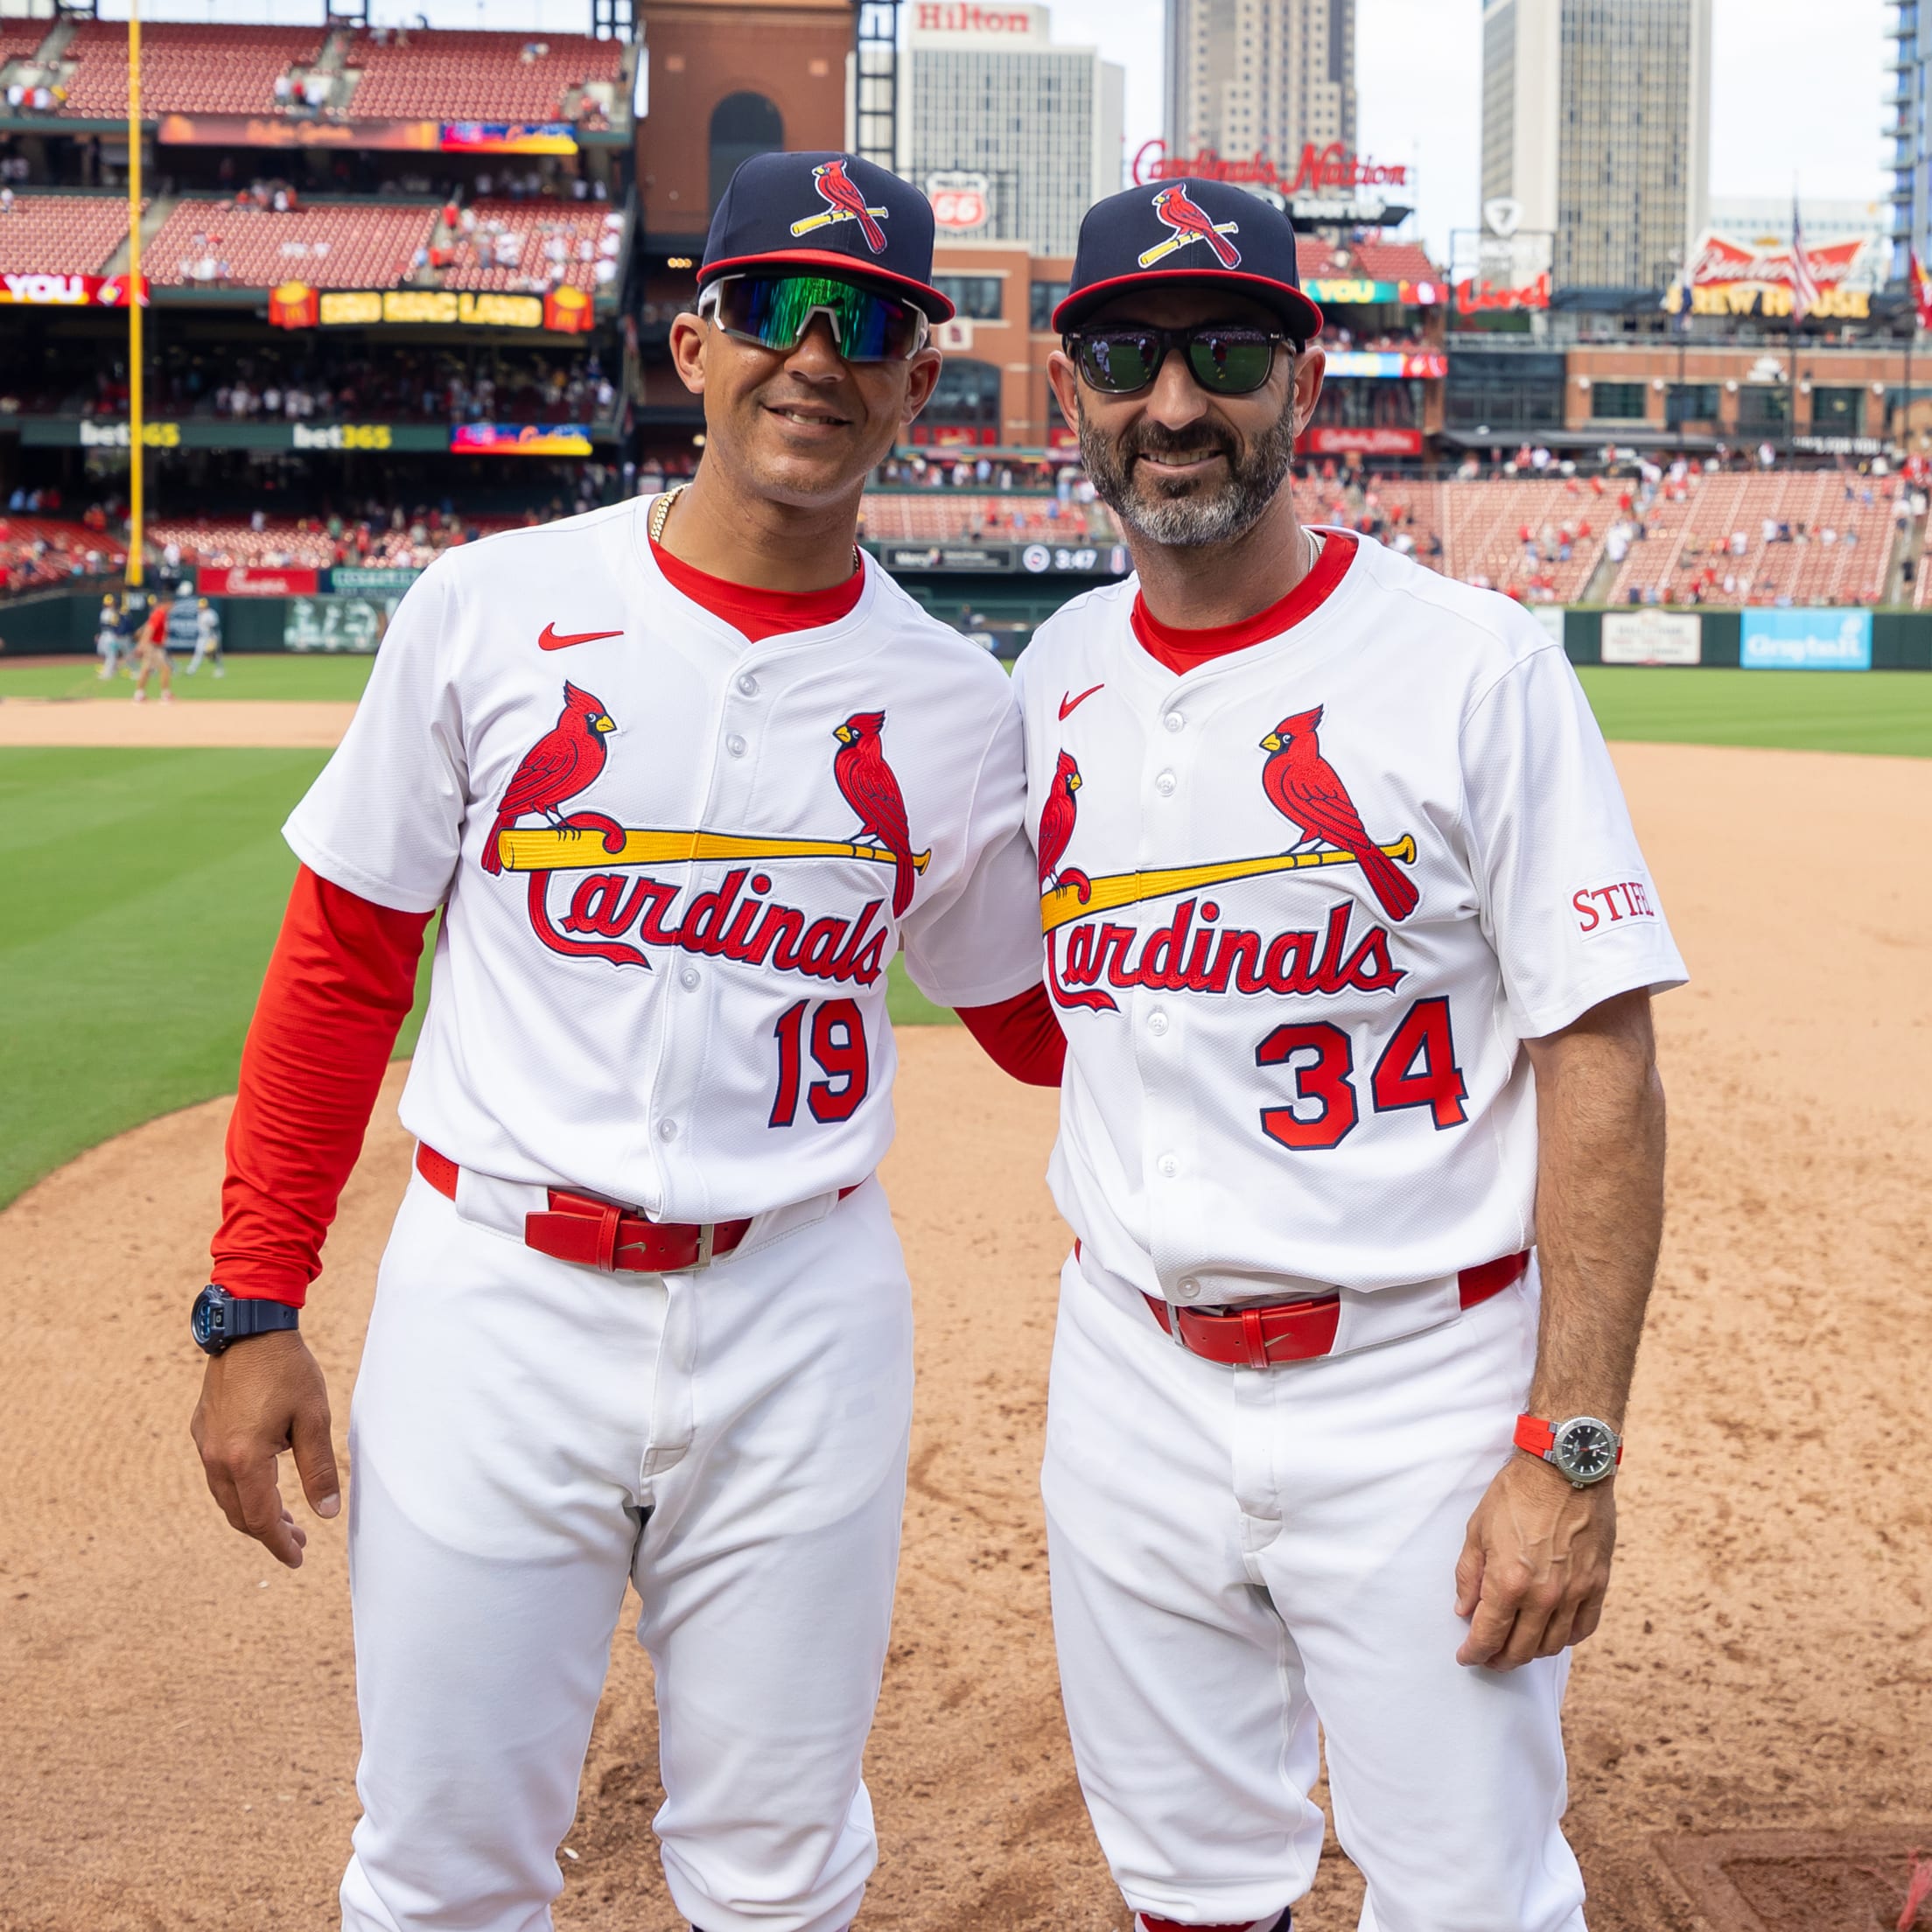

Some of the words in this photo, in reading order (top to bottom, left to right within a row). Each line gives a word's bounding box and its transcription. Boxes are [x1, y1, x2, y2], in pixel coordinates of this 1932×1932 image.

[917, 3, 1029, 32] Hilton
[1132, 140, 1278, 186] Cardinals
[1280, 141, 1406, 193] Nation
[935, 195, 977, 222] 66
[4, 274, 84, 302] YOU
[1316, 278, 1376, 304] YOU
[1761, 286, 1871, 318] HUSE
[80, 421, 180, 447] bet65
[293, 423, 391, 449] bet365
[527, 867, 888, 990] Cardinals
[1046, 896, 1409, 1013] Cardinals
[768, 998, 869, 1129] 19
[1255, 995, 1469, 1152] 34
